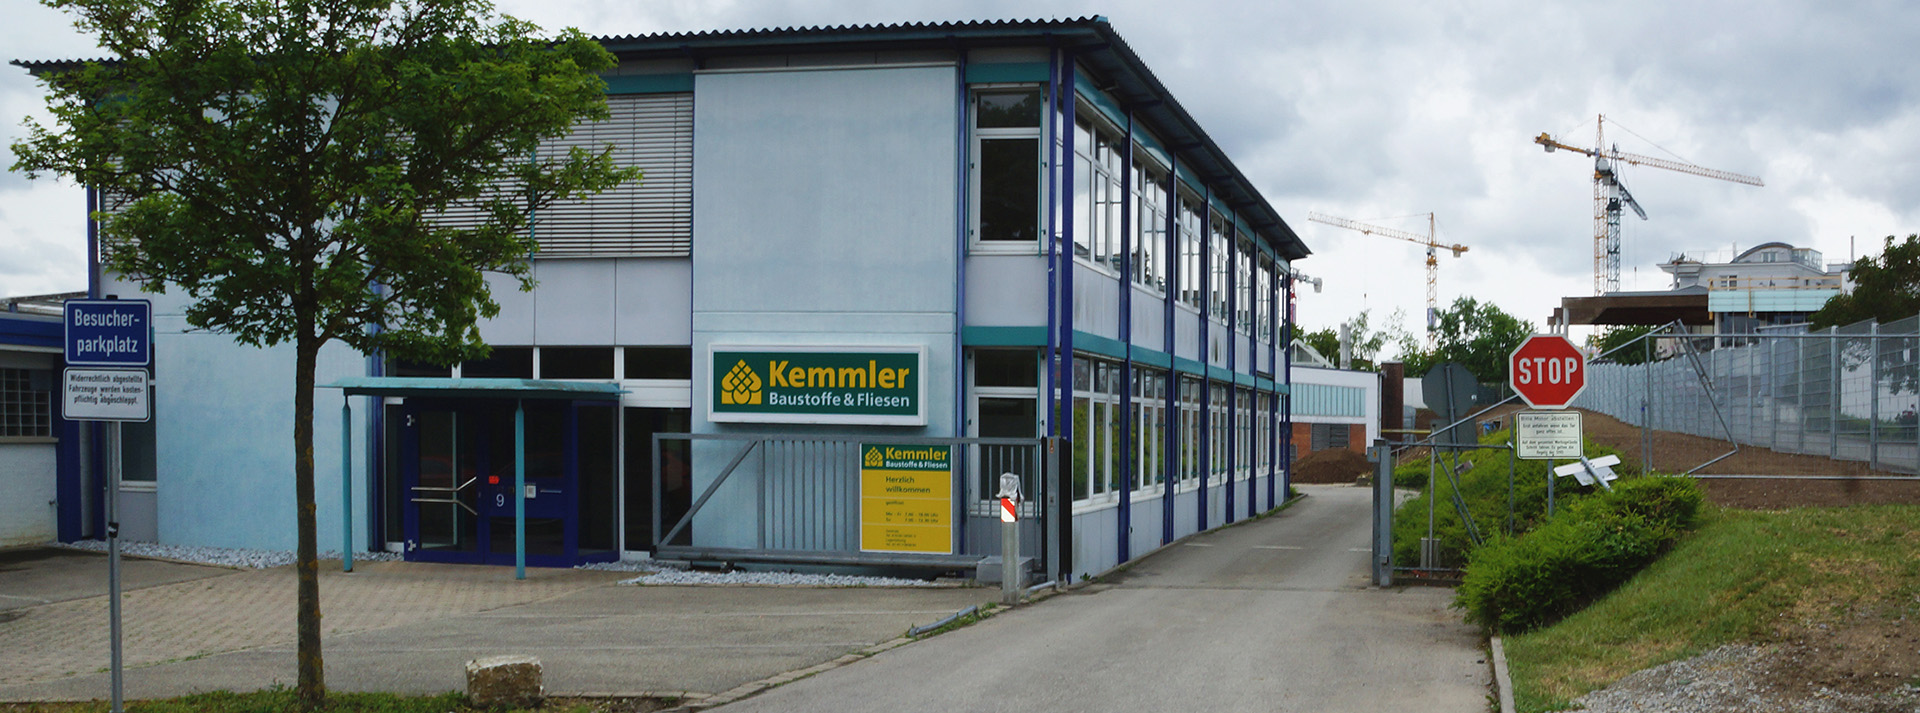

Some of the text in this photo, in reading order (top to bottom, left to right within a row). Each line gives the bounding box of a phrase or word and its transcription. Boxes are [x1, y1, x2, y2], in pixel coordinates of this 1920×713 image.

[75, 309, 140, 326] Besucher-
[77, 335, 138, 357] parkplatz
[769, 360, 910, 389] Kemmler
[1519, 357, 1578, 384] STOP
[70, 374, 142, 384] Widerrechtlich abgestellte
[69, 384, 97, 394] Fahrzeuge
[74, 395, 98, 405] pflichtig
[769, 392, 910, 407] Baustoffe & Fliesen
[885, 447, 947, 460] Kemmler
[496, 494, 505, 507] 9
